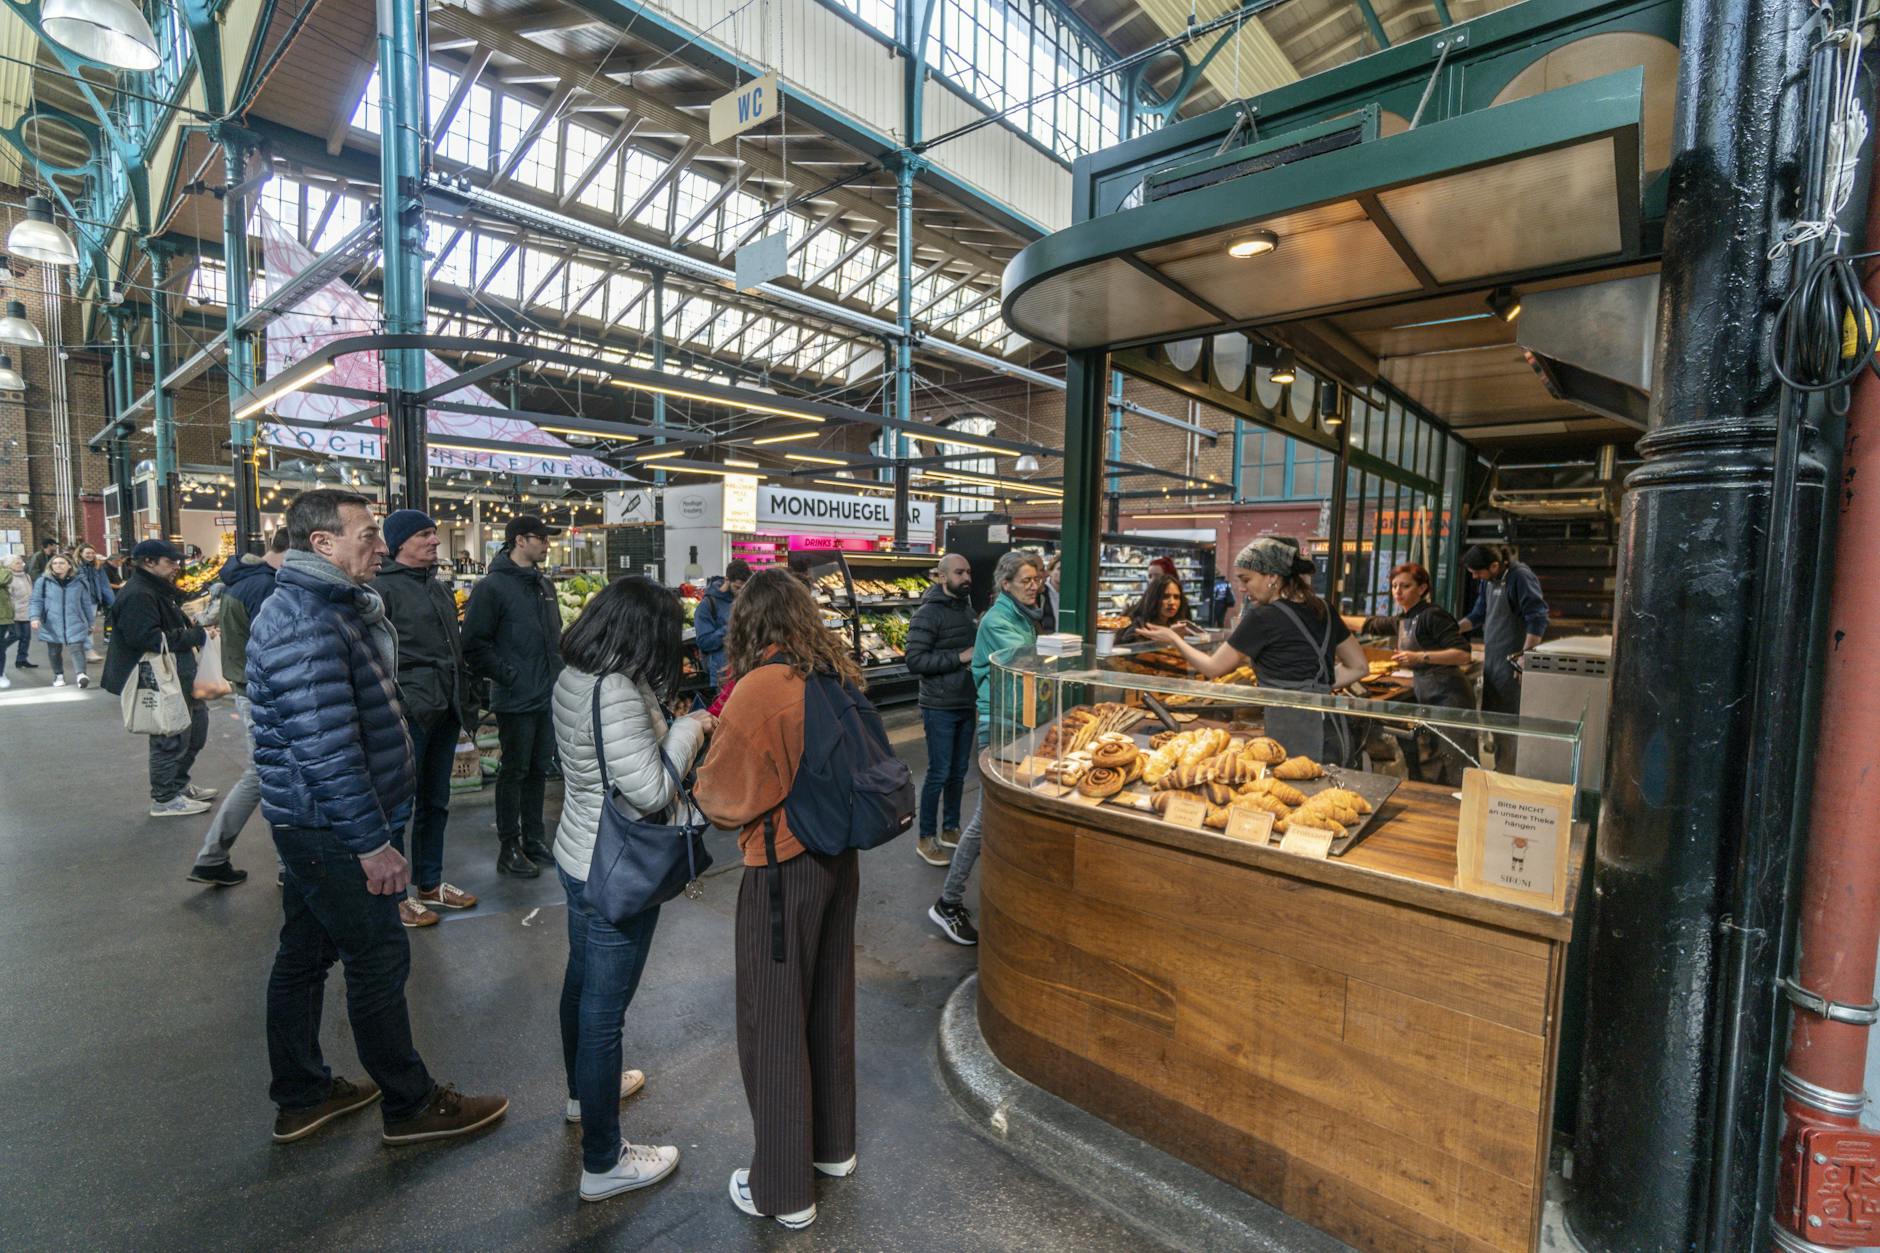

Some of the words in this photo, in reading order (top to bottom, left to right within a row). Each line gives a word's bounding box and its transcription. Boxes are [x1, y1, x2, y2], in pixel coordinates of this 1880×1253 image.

[738, 87, 762, 124] WC
[542, 460, 614, 478] NEUN
[771, 494, 889, 522] MONDHUEGEL
[804, 538, 832, 548] DRINKS
[1498, 801, 1517, 810] Bitte
[1519, 805, 1545, 814] NICHT
[1501, 812, 1528, 820] unsere
[1530, 816, 1555, 825] Theke
[1505, 820, 1536, 831] hängen
